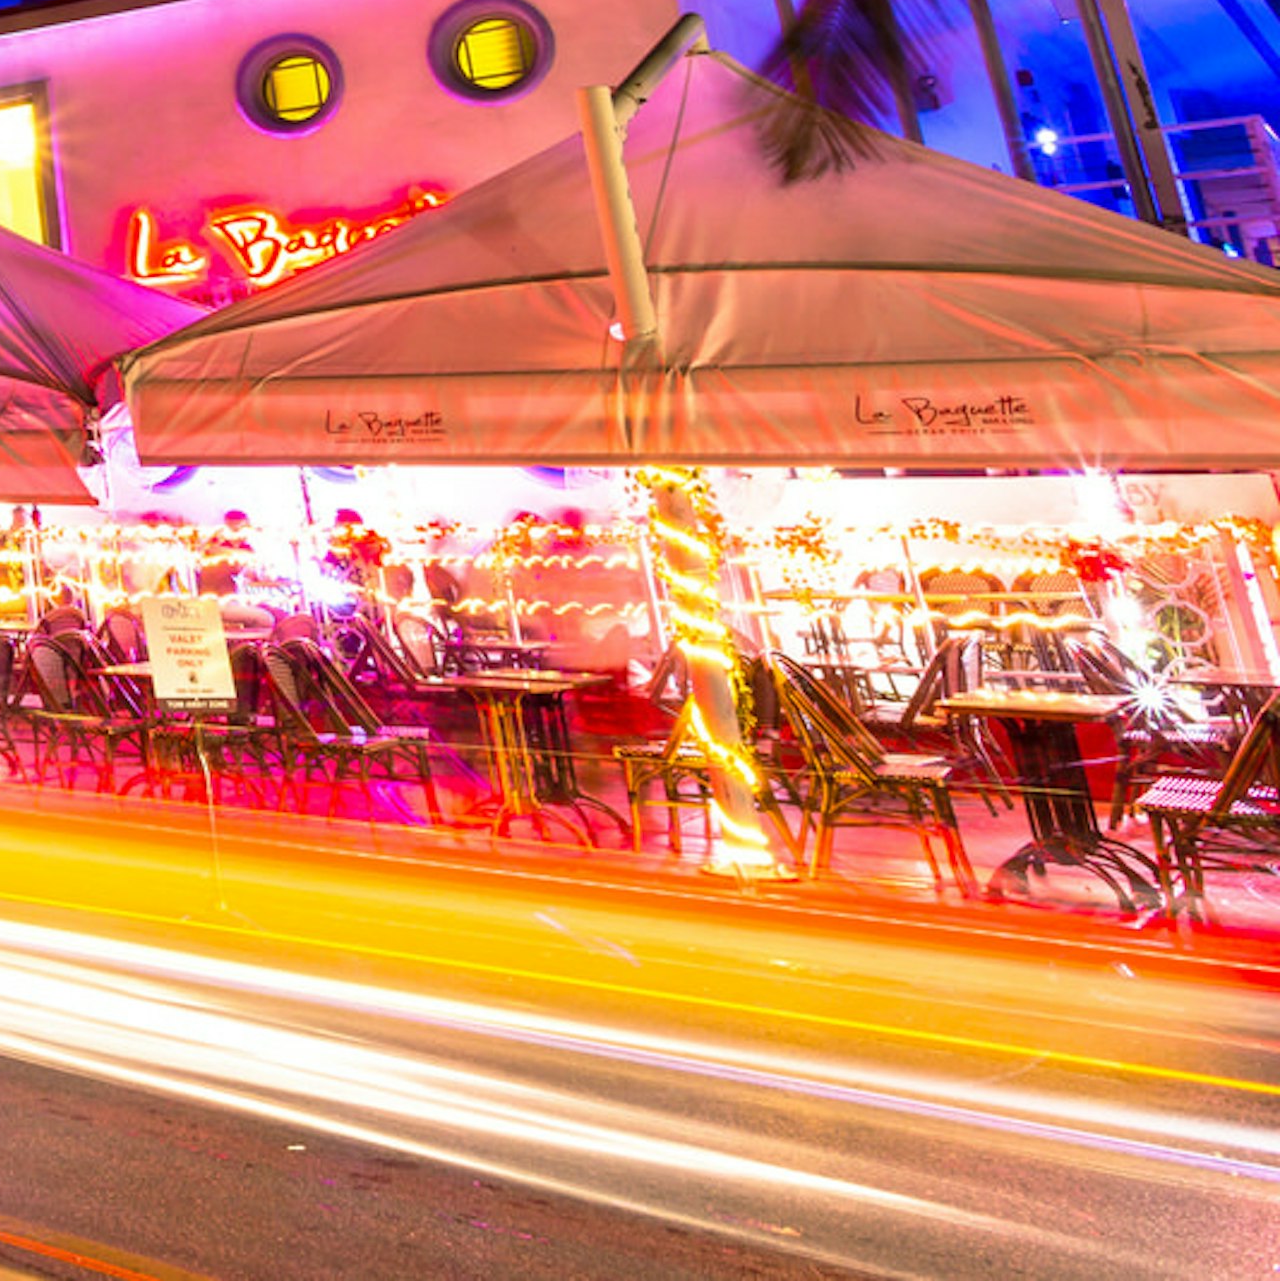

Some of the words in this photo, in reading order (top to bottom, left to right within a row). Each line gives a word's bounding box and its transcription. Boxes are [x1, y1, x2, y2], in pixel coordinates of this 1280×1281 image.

[130, 209, 206, 284] La
[210, 186, 447, 287] Bague
[854, 394, 891, 425] La
[901, 395, 1030, 427] Baguette
[325, 410, 351, 434] La
[358, 412, 443, 436] Baguette
[169, 634, 202, 643] VALET
[166, 647, 211, 656] PARKING
[176, 659, 203, 667] ONLY
